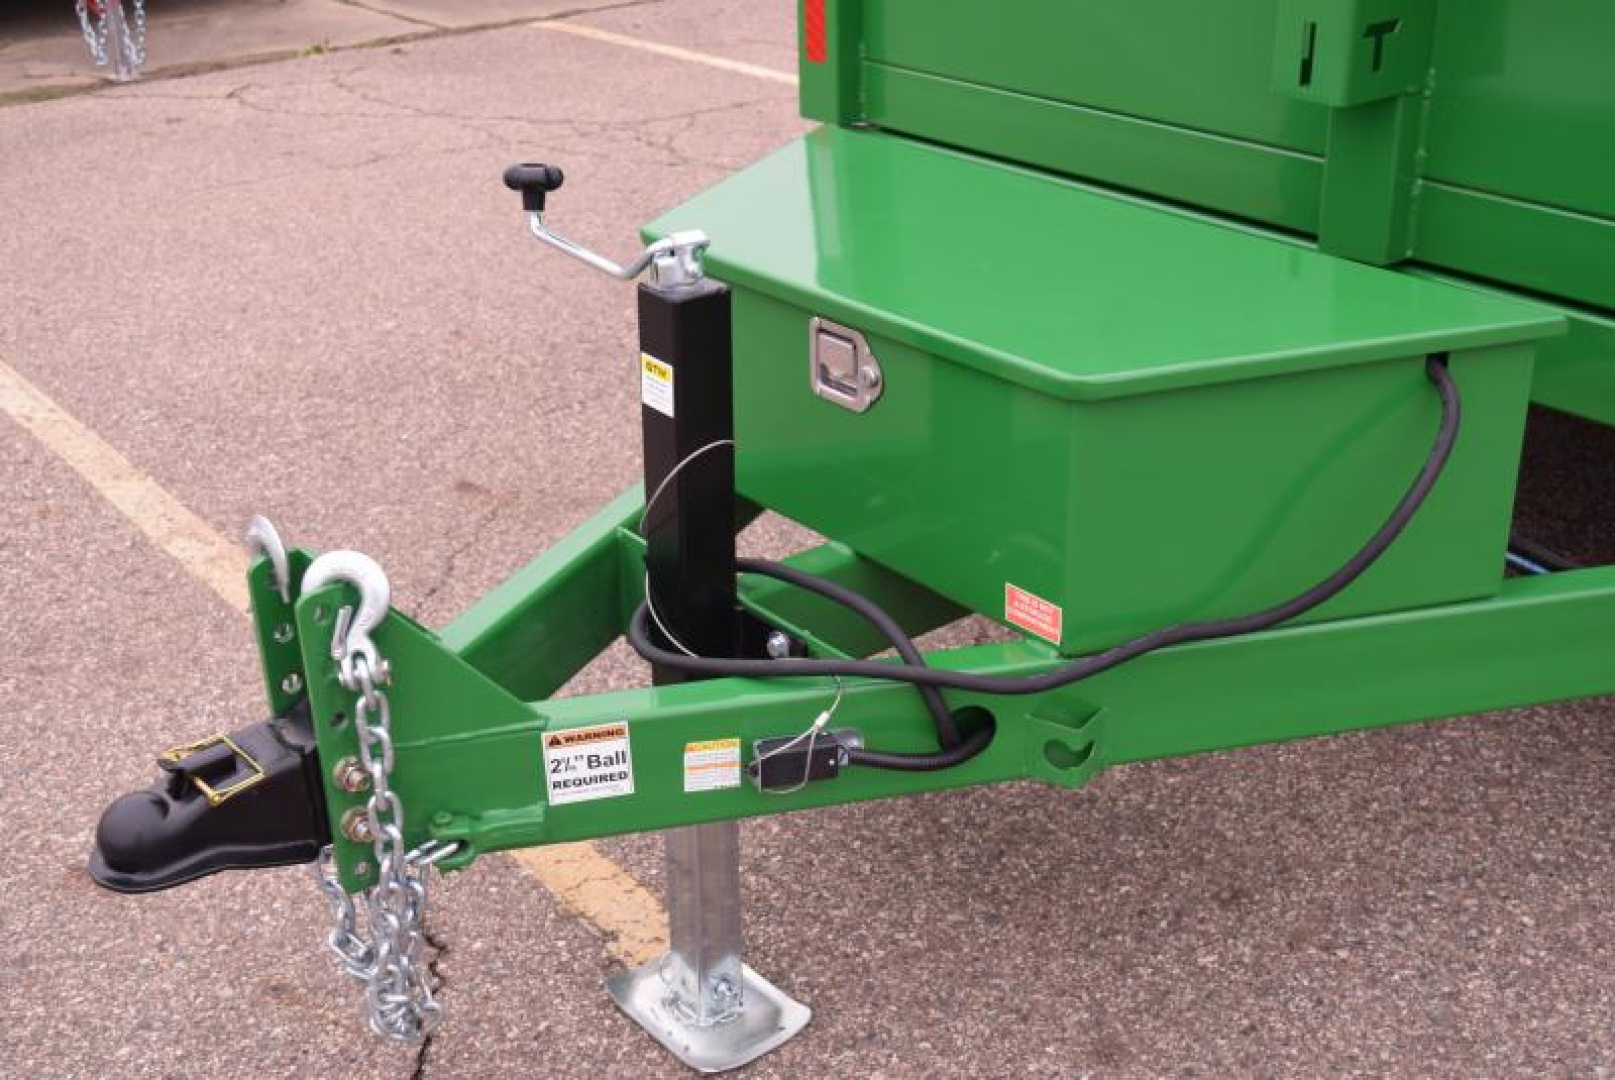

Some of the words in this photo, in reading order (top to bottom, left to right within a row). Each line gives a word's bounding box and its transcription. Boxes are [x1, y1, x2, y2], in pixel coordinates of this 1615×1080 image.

[562, 728, 625, 743] WARNING
[587, 750, 627, 769] Ball
[552, 770, 628, 790] REQUIRED
